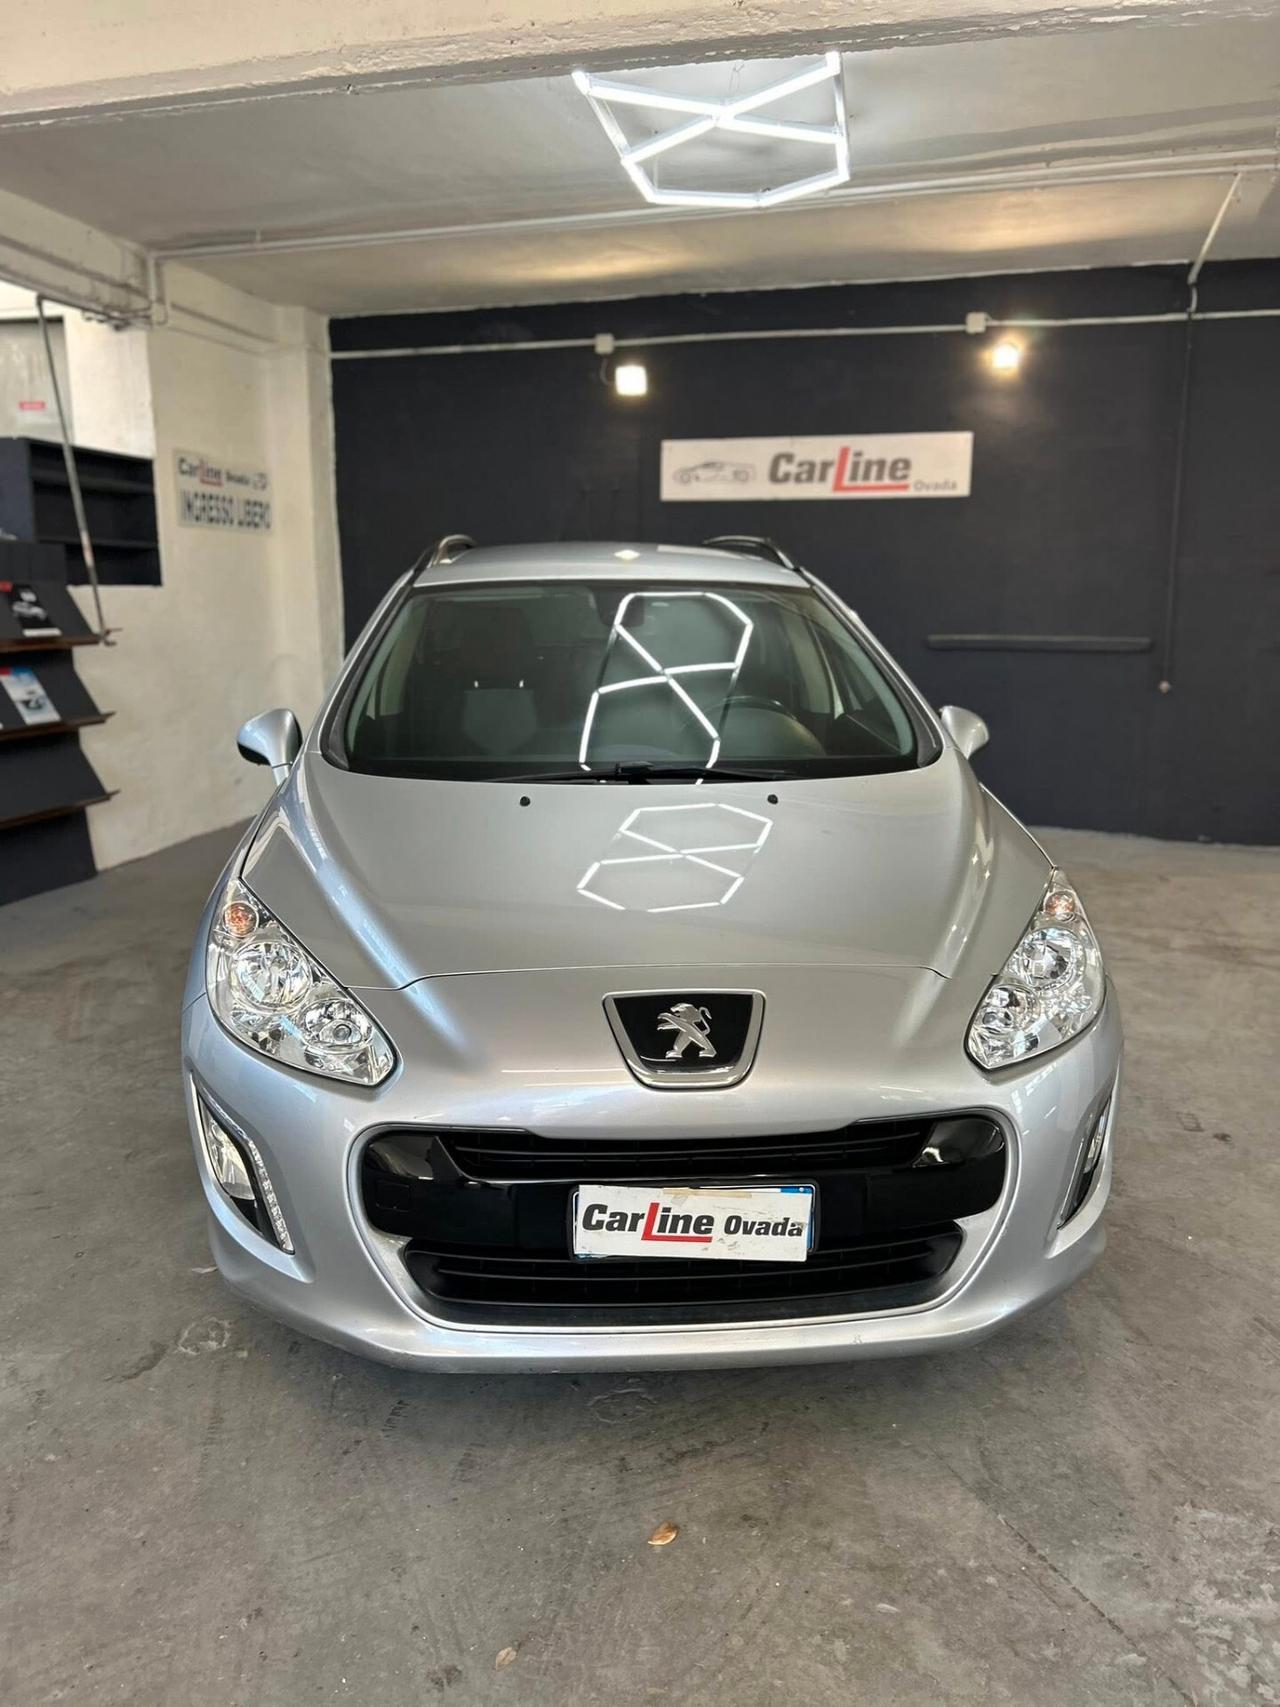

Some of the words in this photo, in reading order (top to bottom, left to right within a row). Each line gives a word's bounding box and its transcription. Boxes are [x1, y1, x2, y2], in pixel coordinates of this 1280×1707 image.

[768, 446, 912, 493] CarLine
[913, 479, 957, 492] Ovada
[582, 1202, 715, 1244] CarLine
[723, 1215, 804, 1238] Ovada
